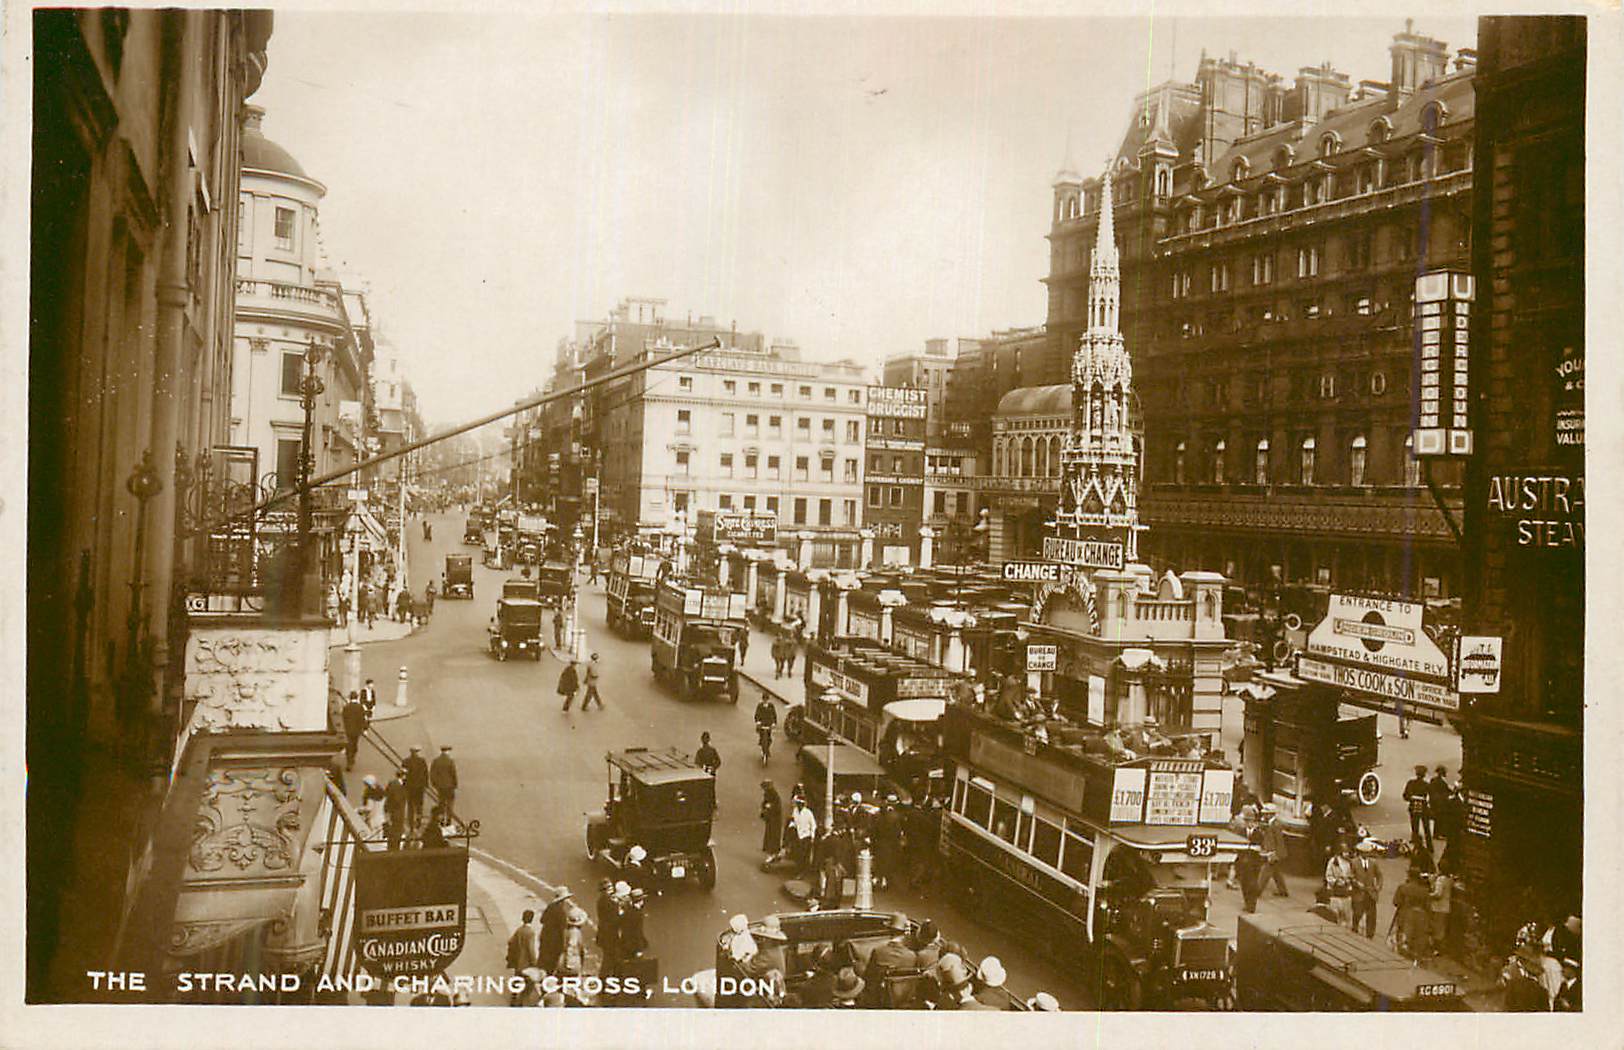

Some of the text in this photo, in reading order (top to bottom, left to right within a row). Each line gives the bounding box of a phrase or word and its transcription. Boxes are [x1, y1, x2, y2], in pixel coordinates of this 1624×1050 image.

[1556, 358, 1584, 378] YOU
[868, 387, 927, 403] CHEMIST
[867, 402, 927, 418] DRUGGIST
[1044, 538, 1077, 562] BUREAU
[1084, 543, 1121, 567] CHANGE
[1004, 563, 1058, 580] CHANGE
[1340, 595, 1412, 614] ENTRANCE TO
[1029, 646, 1056, 655] BUREAU
[1310, 643, 1361, 660] HAMPSTEAD
[1363, 652, 1370, 662] &
[1372, 654, 1420, 670] HIGHGATE
[1028, 660, 1055, 669] CHANGE
[1358, 670, 1388, 693] COOK
[1394, 678, 1416, 699] SON
[366, 909, 455, 928] BUFFET BAR
[383, 958, 438, 973] WHISKY
